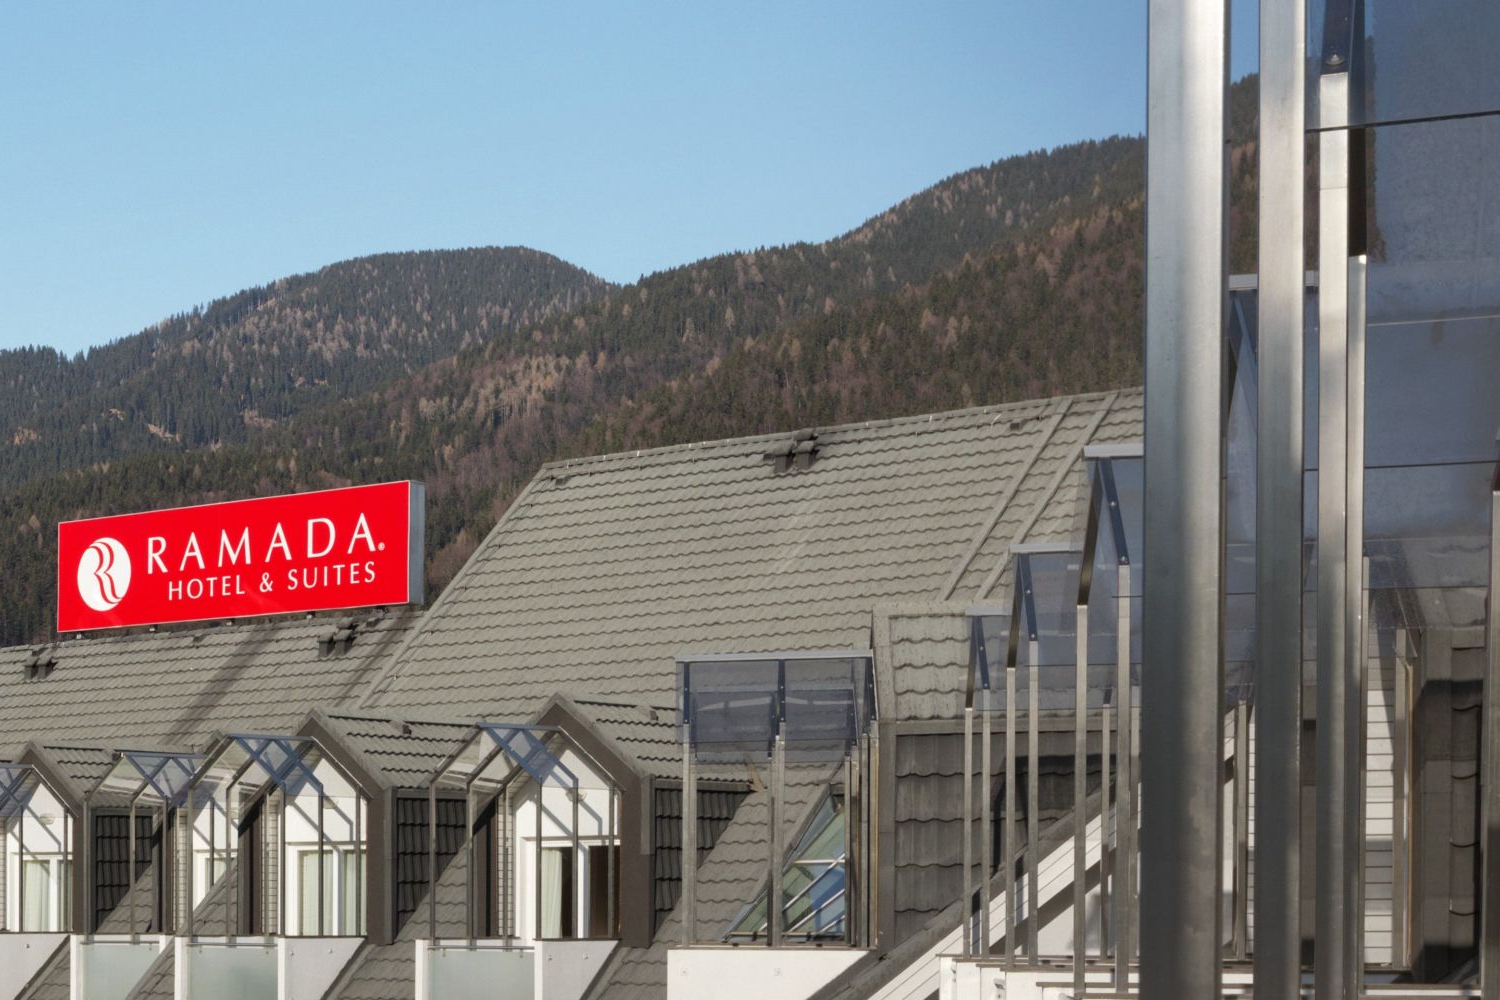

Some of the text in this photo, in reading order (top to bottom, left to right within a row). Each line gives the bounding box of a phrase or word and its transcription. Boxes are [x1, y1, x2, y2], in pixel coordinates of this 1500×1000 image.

[168, 561, 376, 601] HOTEL & SUITES
